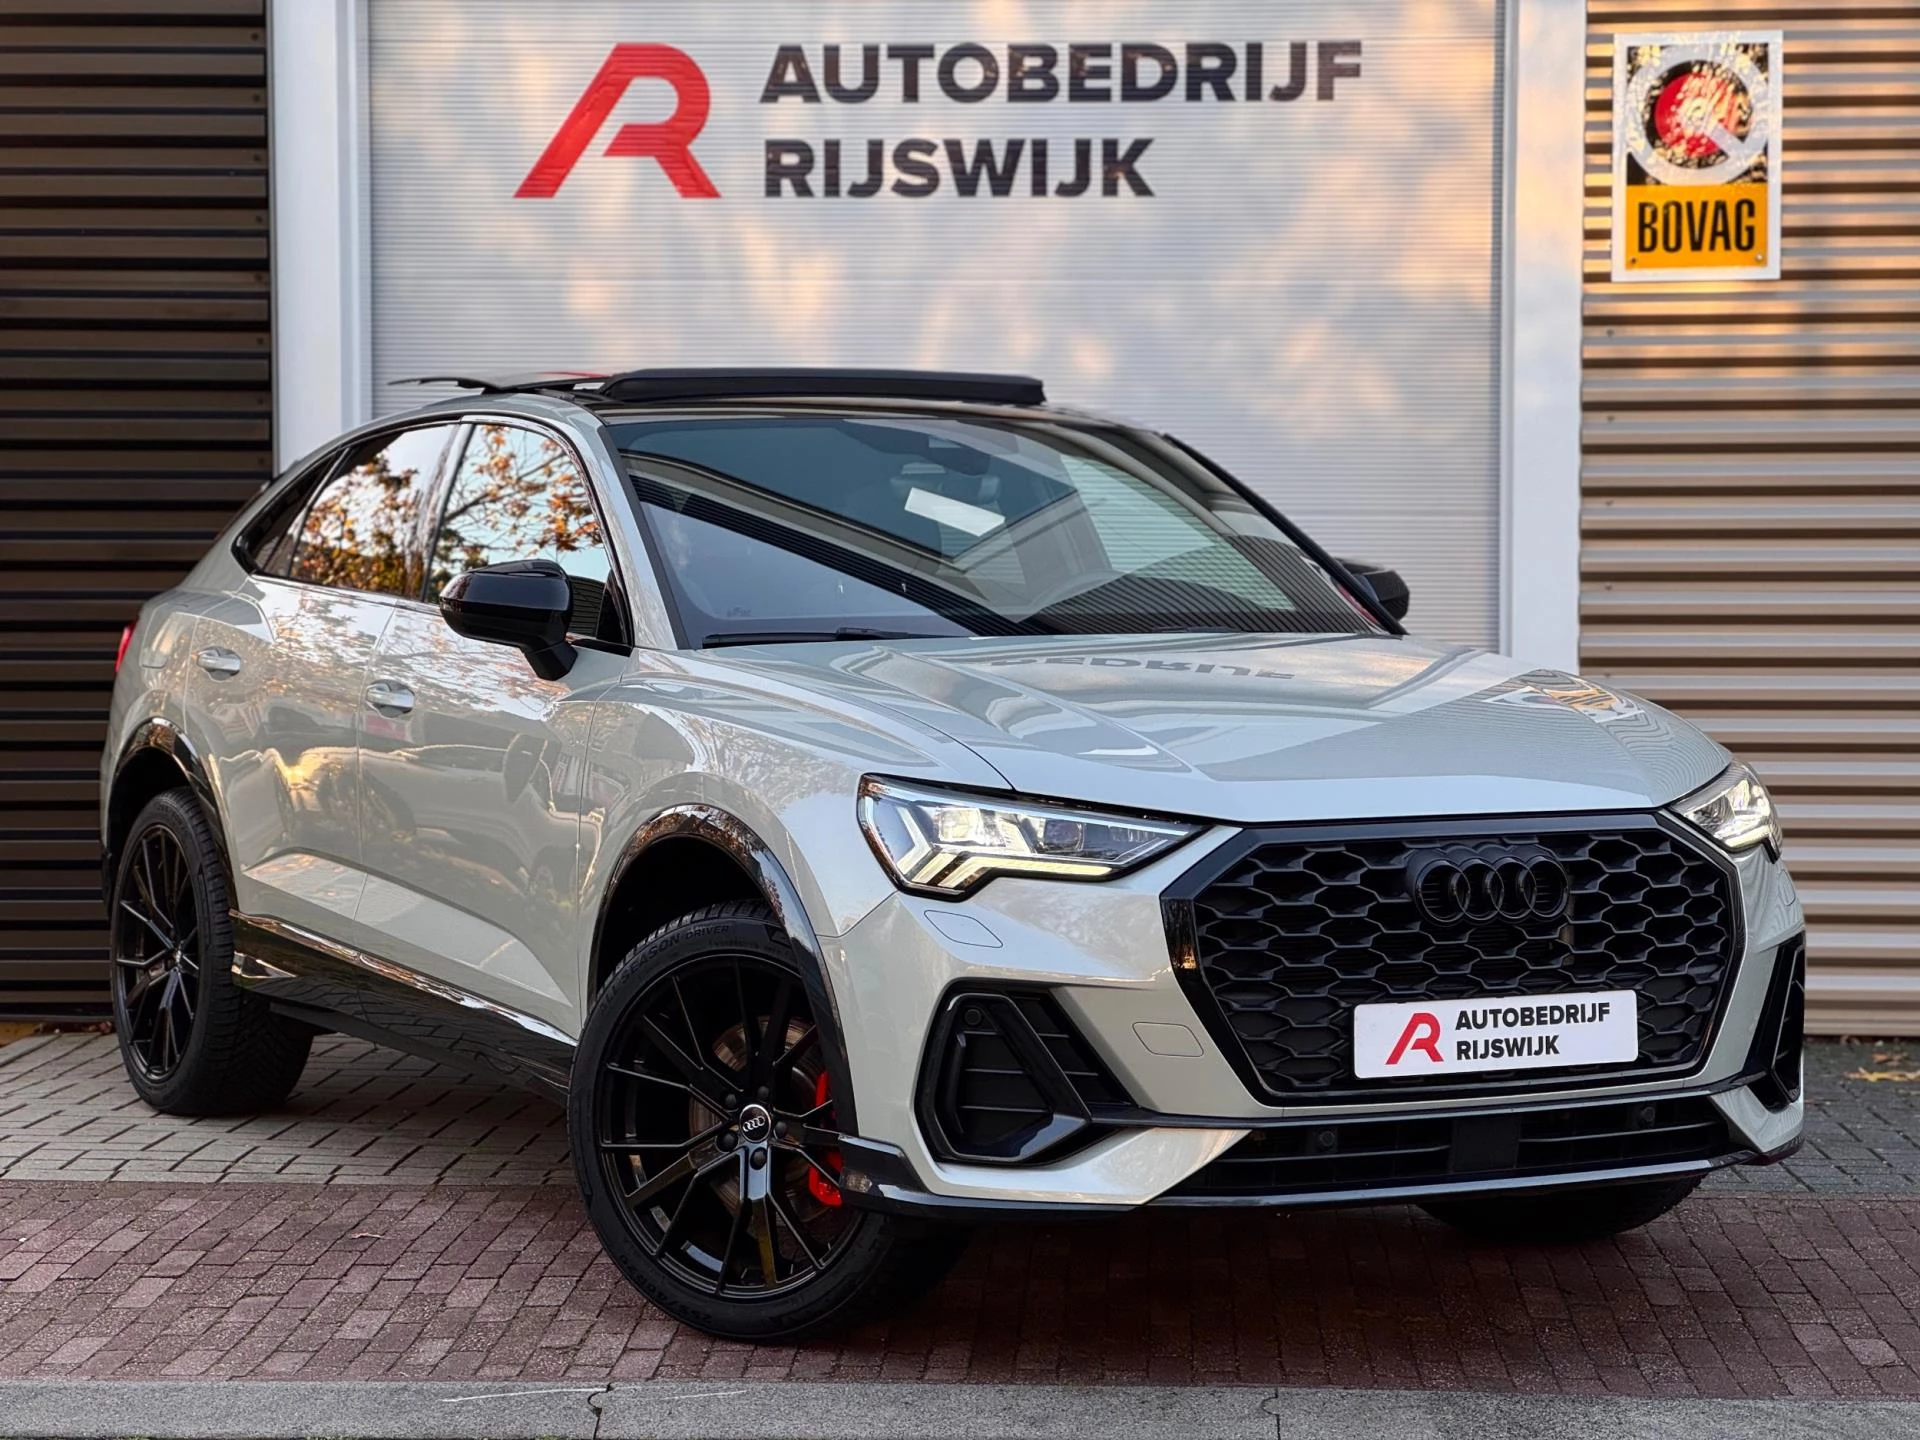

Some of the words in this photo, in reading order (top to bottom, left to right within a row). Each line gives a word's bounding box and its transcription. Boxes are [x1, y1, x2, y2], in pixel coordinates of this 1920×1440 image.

[761, 42, 1361, 103] AUTOBEDRIJF
[766, 138, 1154, 197] RIJSWIJK
[1638, 199, 1755, 253] BOVAG
[621, 933, 681, 985] SEASON
[685, 924, 730, 942] DRIVER
[1455, 1002, 1610, 1030] AUTOBEDRIJF
[1456, 1035, 1560, 1061] RIJSWIJK
